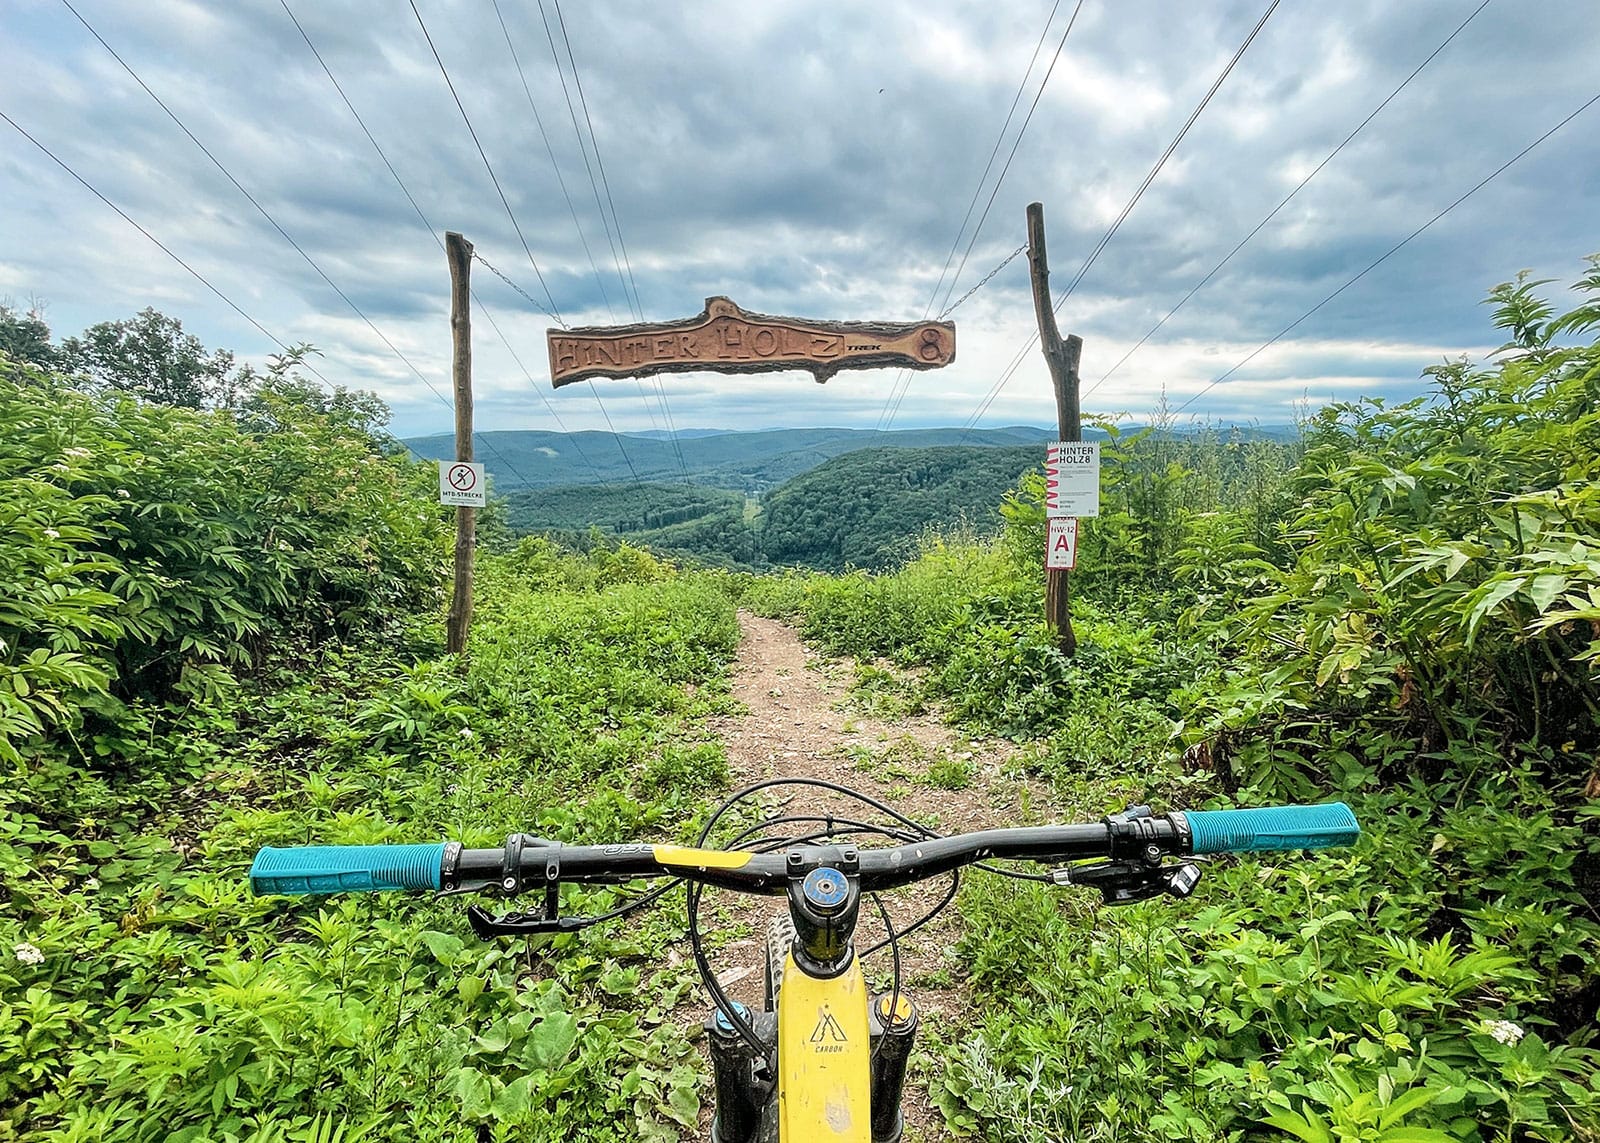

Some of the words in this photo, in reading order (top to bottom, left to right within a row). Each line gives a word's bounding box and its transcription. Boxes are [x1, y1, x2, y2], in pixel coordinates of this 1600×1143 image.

[552, 335, 699, 374] HINTER
[716, 324, 839, 359] HOLZ
[920, 328, 941, 361] 8
[1060, 446, 1094, 455] HINTER
[1060, 455, 1091, 464] HOLZ8
[1054, 534, 1070, 552] A
[815, 1045, 843, 1053] CARBON
